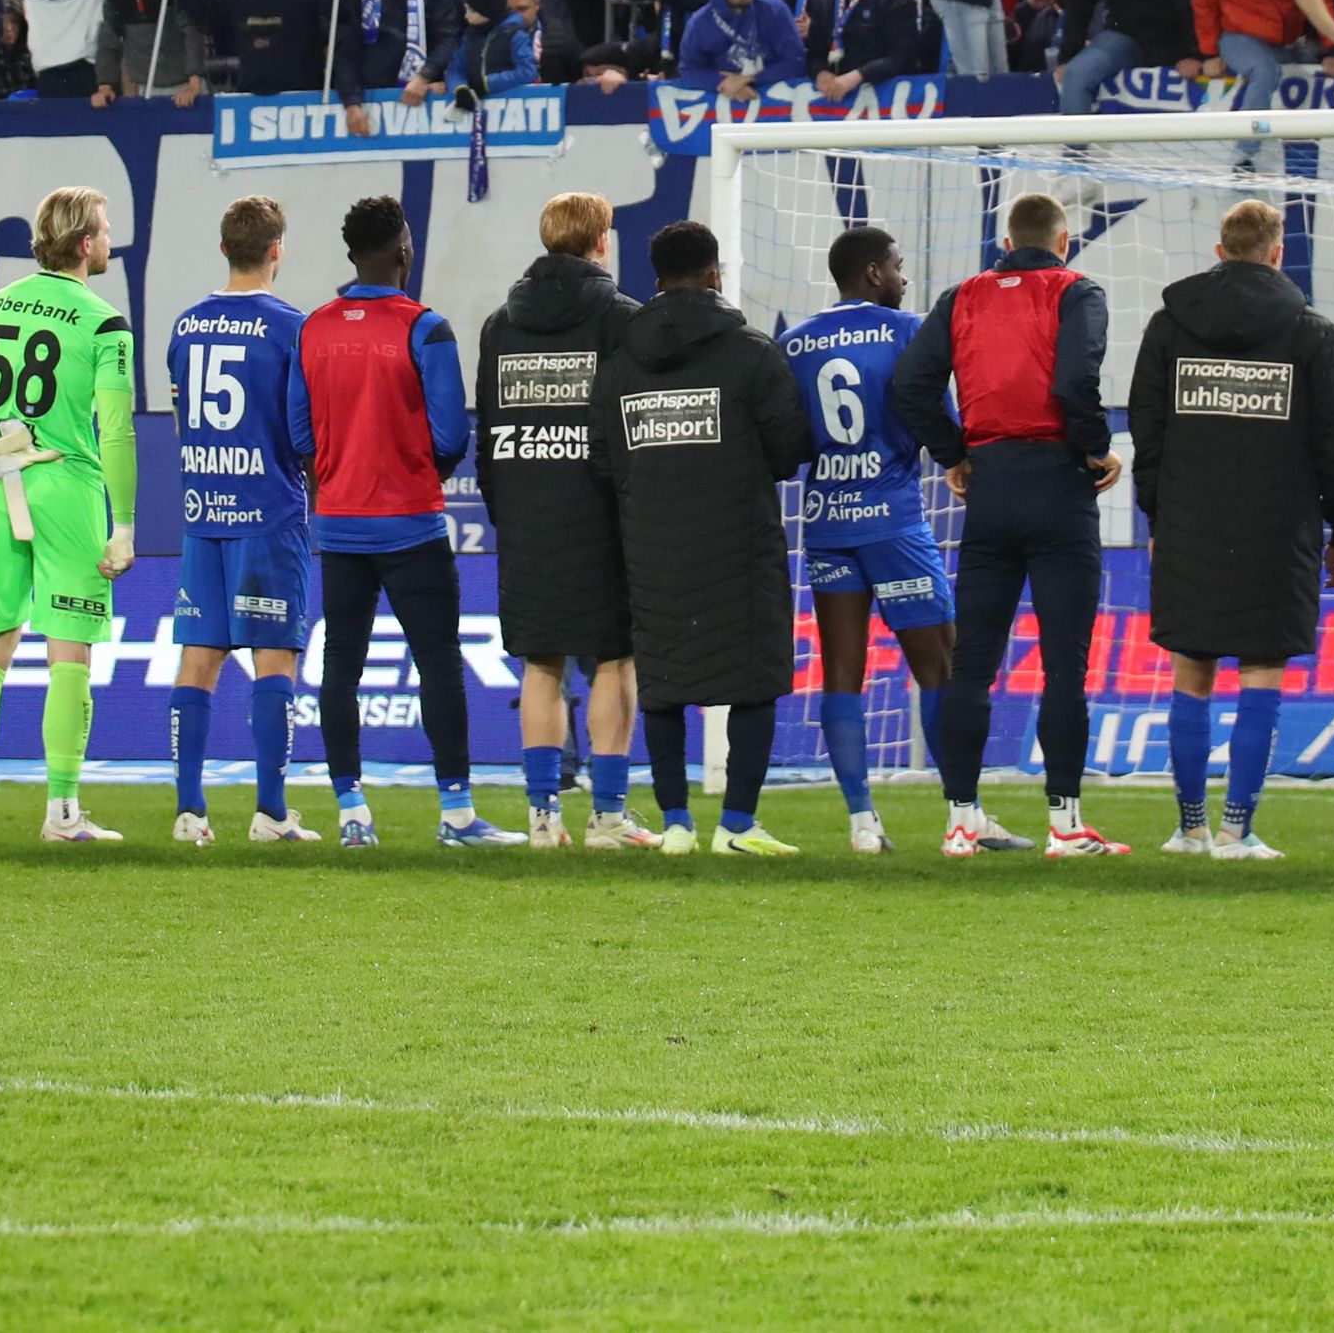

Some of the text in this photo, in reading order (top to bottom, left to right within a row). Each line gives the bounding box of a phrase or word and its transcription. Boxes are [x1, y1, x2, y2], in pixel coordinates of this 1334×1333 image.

[178, 313, 269, 338] Oberbank
[786, 323, 895, 357] Oberbank
[501, 354, 594, 373] machsport
[1179, 362, 1290, 382] machsport
[188, 343, 246, 430] 15
[504, 379, 589, 404] uhlsport
[624, 391, 717, 415] machsport
[816, 358, 866, 446] 6
[1182, 386, 1285, 414] uhlsport
[631, 416, 715, 445] uhlsport
[205, 490, 237, 508] Linz
[827, 489, 862, 505] Linz
[205, 505, 263, 527] Airport
[826, 502, 891, 523] Airport
[872, 575, 934, 598] LEEB
[51, 594, 107, 616] LEEB
[233, 594, 288, 612] LEEB
